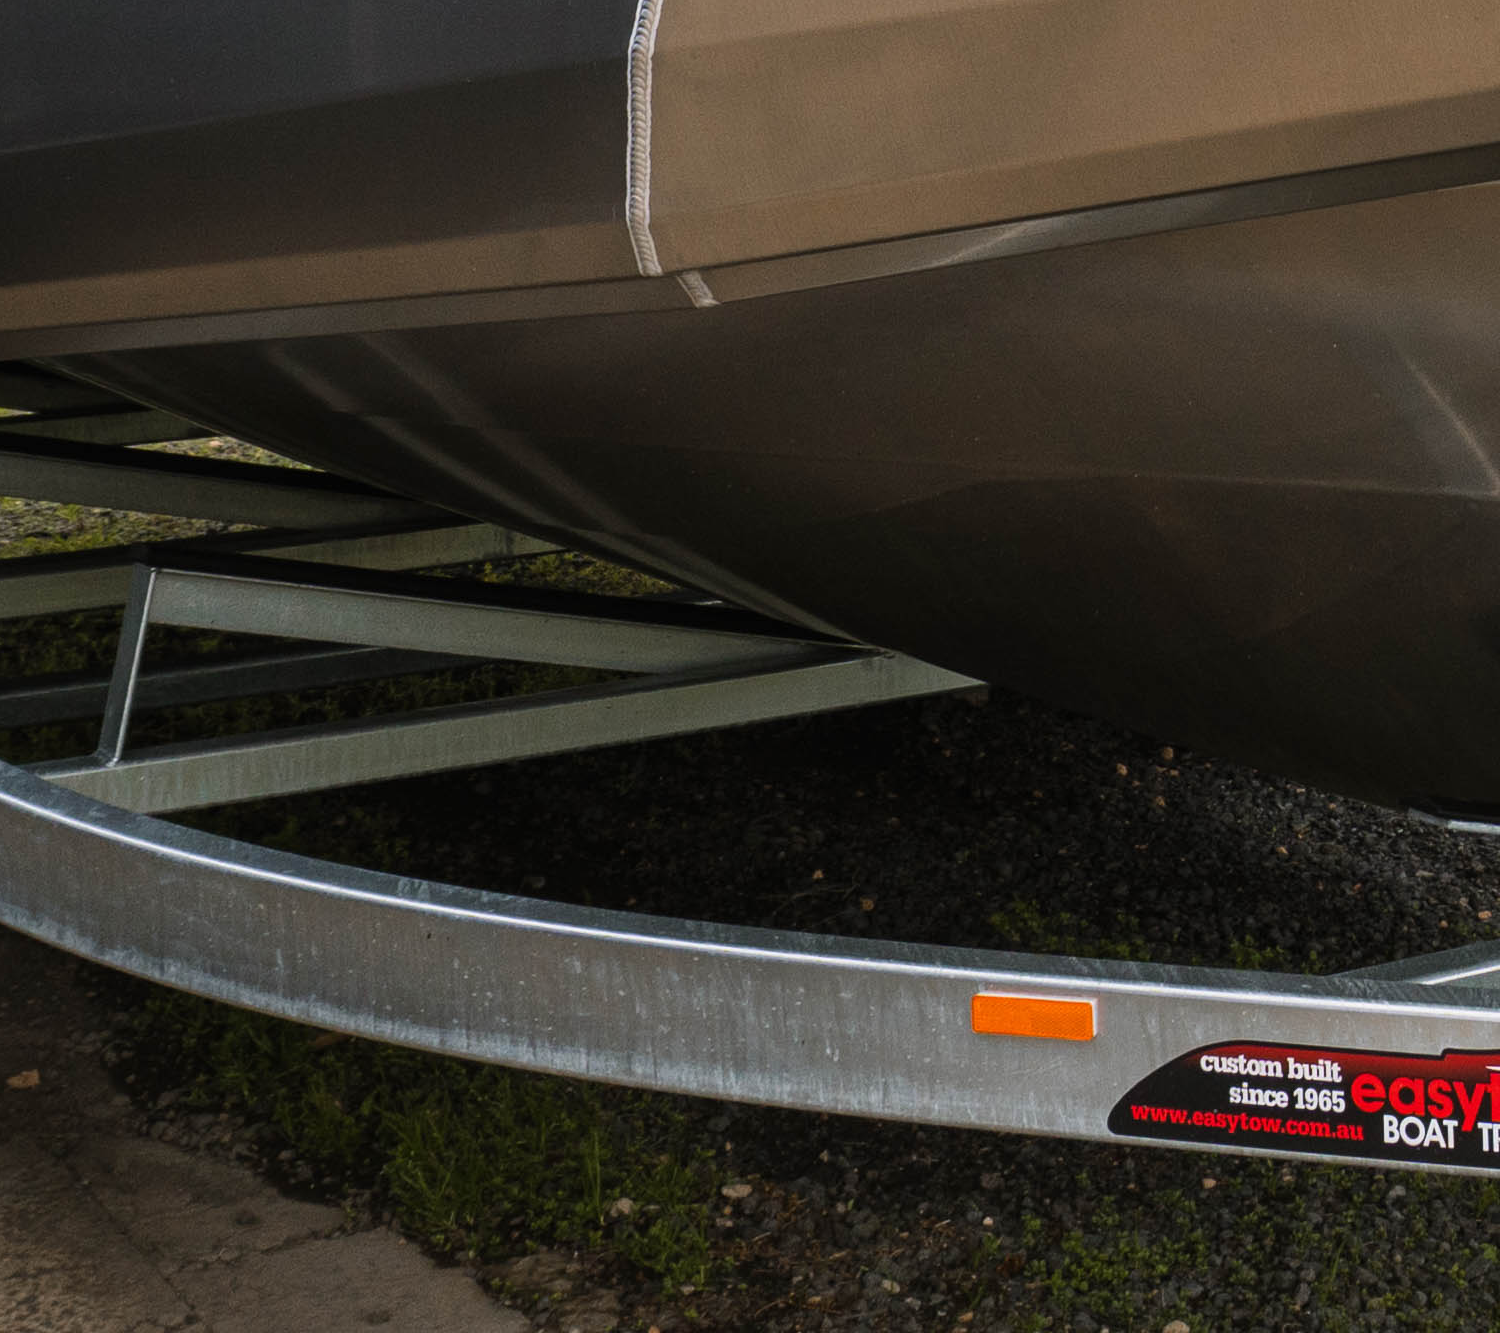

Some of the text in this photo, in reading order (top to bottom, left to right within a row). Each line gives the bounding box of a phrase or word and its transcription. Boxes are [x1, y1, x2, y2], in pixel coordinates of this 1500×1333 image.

[1200, 1053, 1342, 1083] custom built
[1229, 1083, 1346, 1113] since 1965
[1131, 1102, 1365, 1142] www.easytow.com.au
[1383, 1114, 1457, 1150] BOAT
